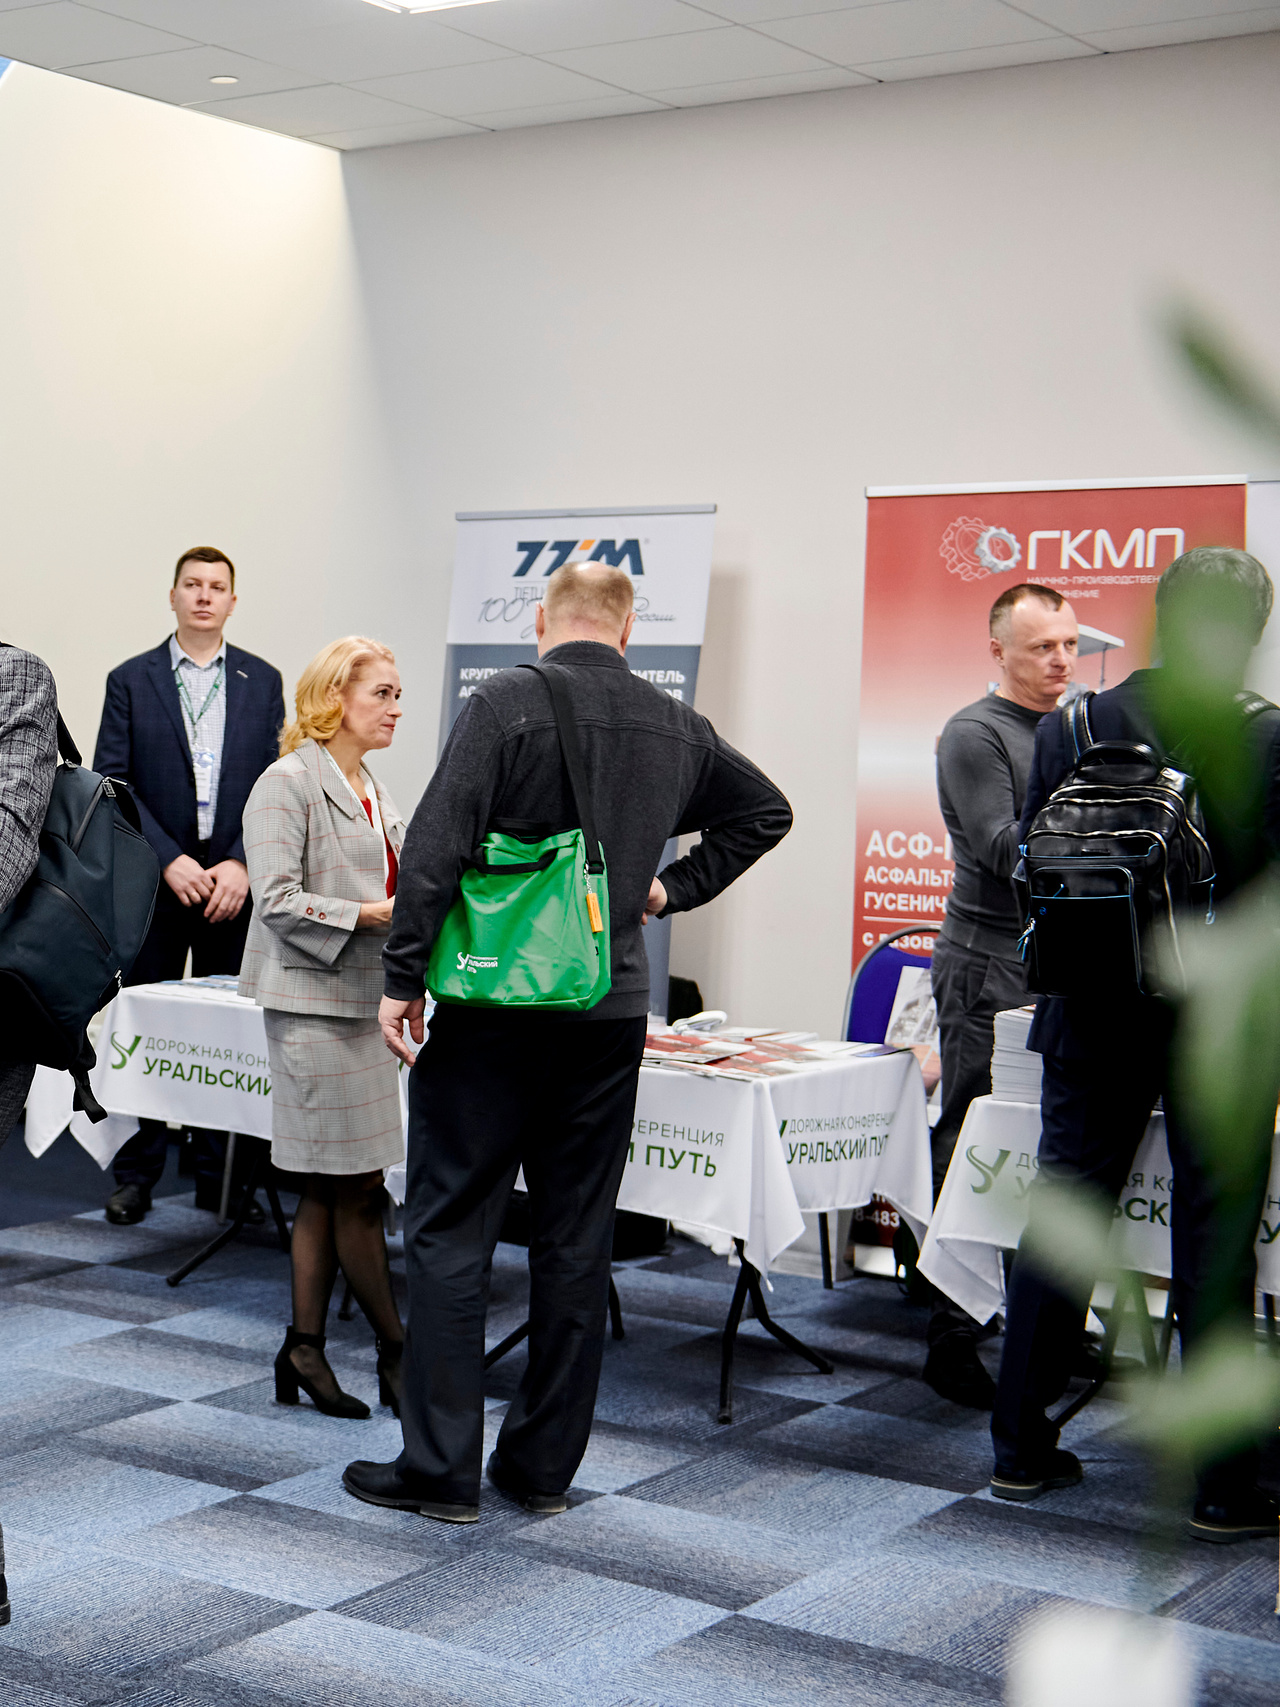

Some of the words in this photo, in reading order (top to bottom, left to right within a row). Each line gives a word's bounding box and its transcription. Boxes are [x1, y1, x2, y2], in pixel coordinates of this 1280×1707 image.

[1026, 527, 1185, 571] ГКМП
[1026, 575, 1162, 586] НАУЧНО-ПРОИЗВОДСТВЕН
[863, 865, 956, 887] АСФАЛЬТ
[863, 890, 948, 914] ГУСЕНИЧ
[145, 1036, 233, 1061] ДОРОЖНАЯ
[237, 1051, 271, 1069] КОН
[632, 1119, 725, 1147] ЕРЕНЦИЯ
[645, 1144, 717, 1178] ПУТЬ
[786, 1133, 867, 1165] УРАЛЬСКИЙ
